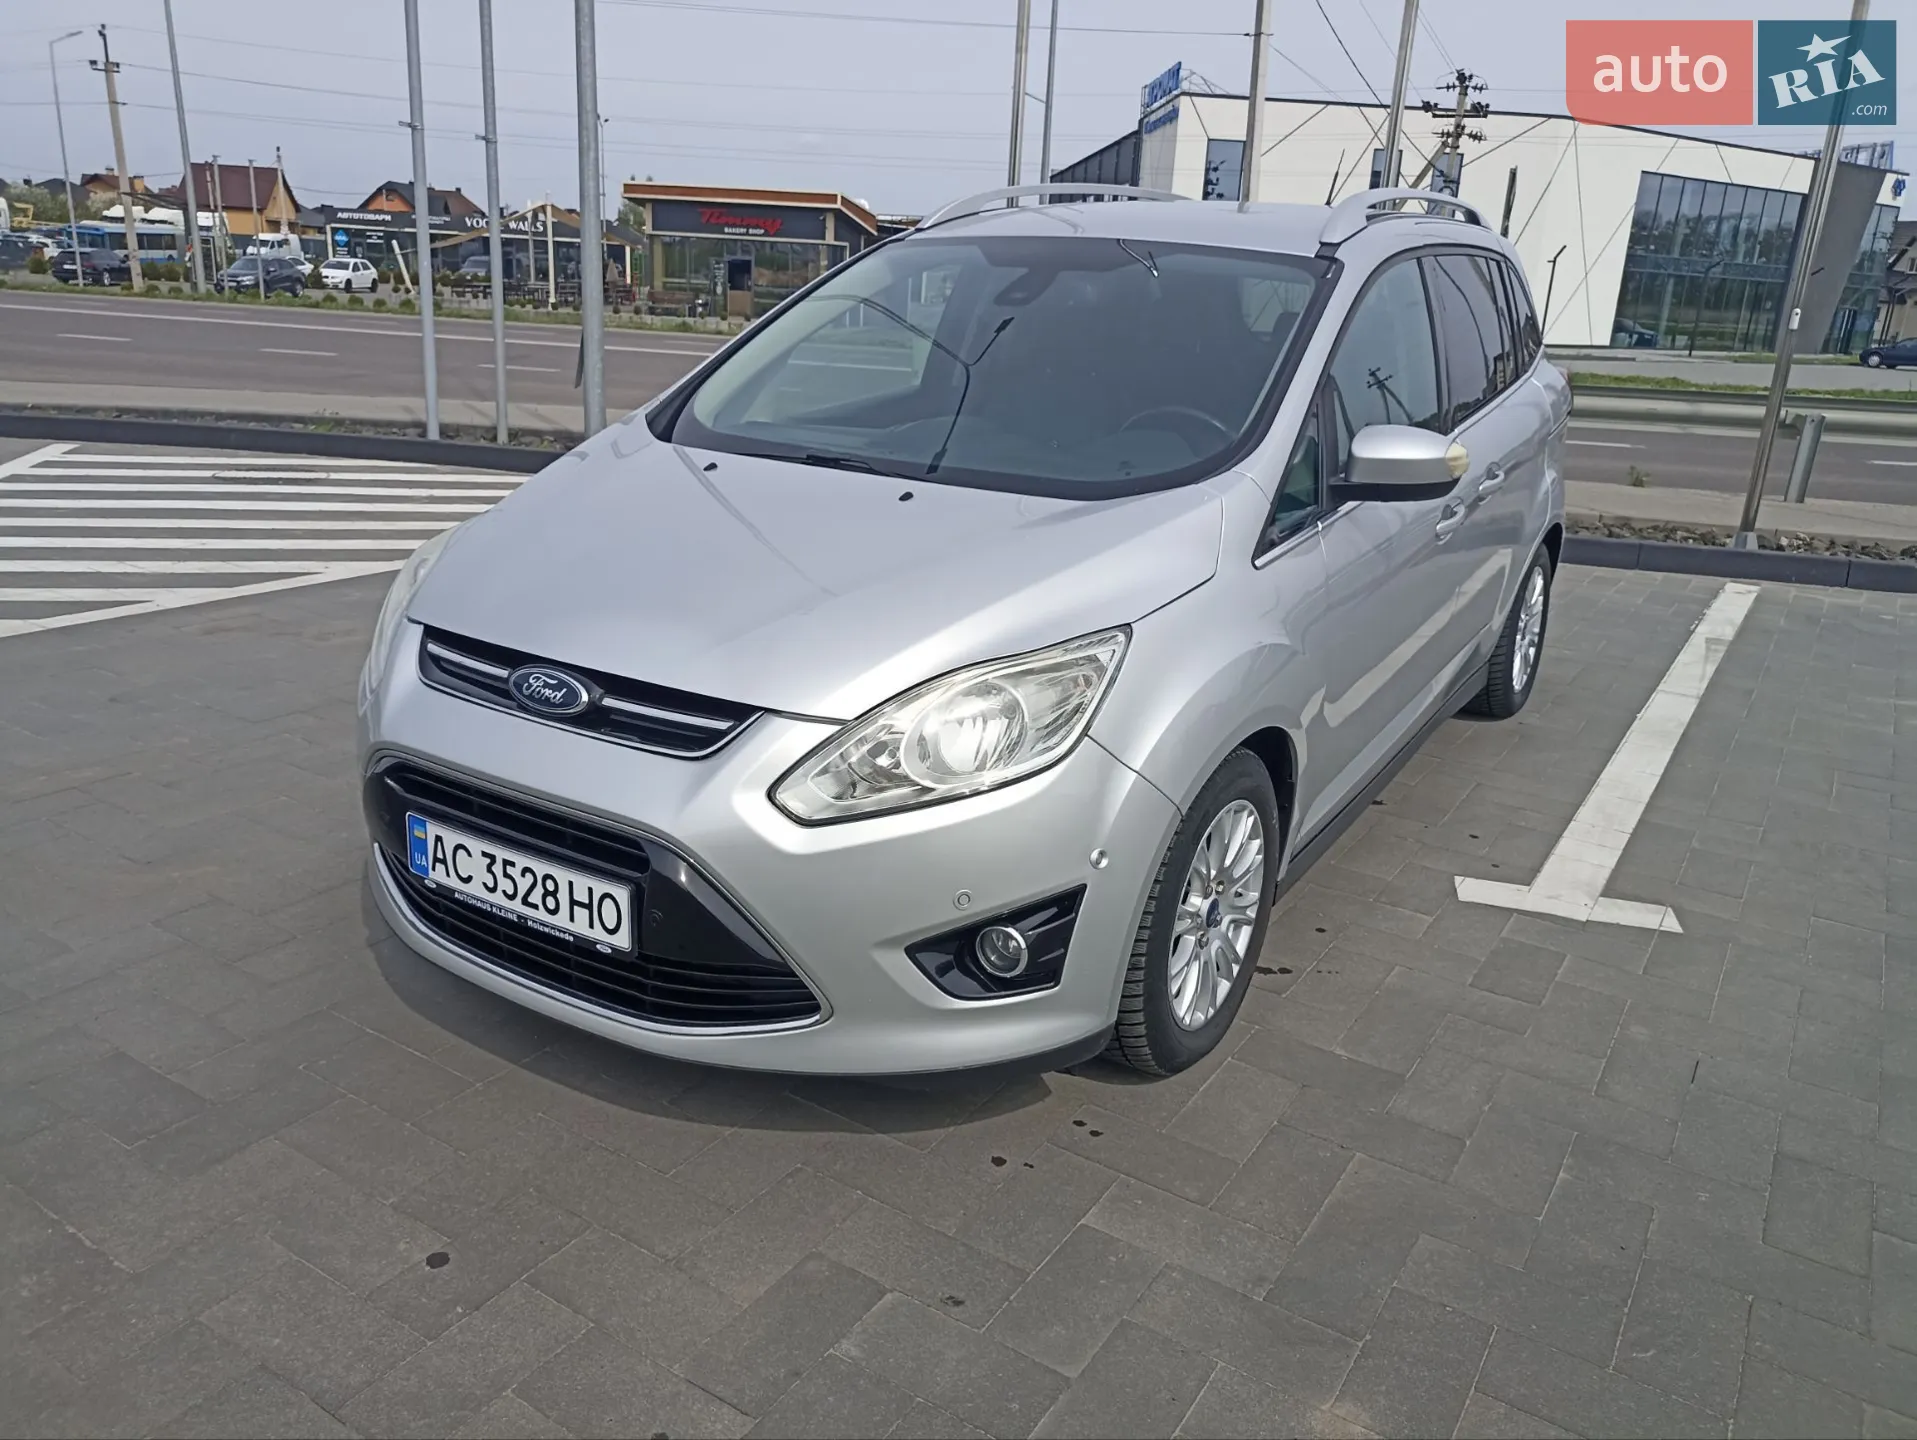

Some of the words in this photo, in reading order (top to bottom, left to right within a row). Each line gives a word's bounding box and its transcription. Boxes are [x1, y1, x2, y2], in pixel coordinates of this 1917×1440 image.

[336, 212, 392, 221] АВТОТОВАРИ
[724, 226, 747, 235] BAKERY
[522, 673, 567, 704] Ford
[415, 852, 427, 868] UA
[431, 834, 474, 884] AC
[480, 850, 561, 916] 3528
[568, 879, 622, 936] HO
[454, 891, 492, 911] AUTOHAUS
[492, 907, 519, 922] KLEINE
[527, 918, 574, 941] Holzwickede
